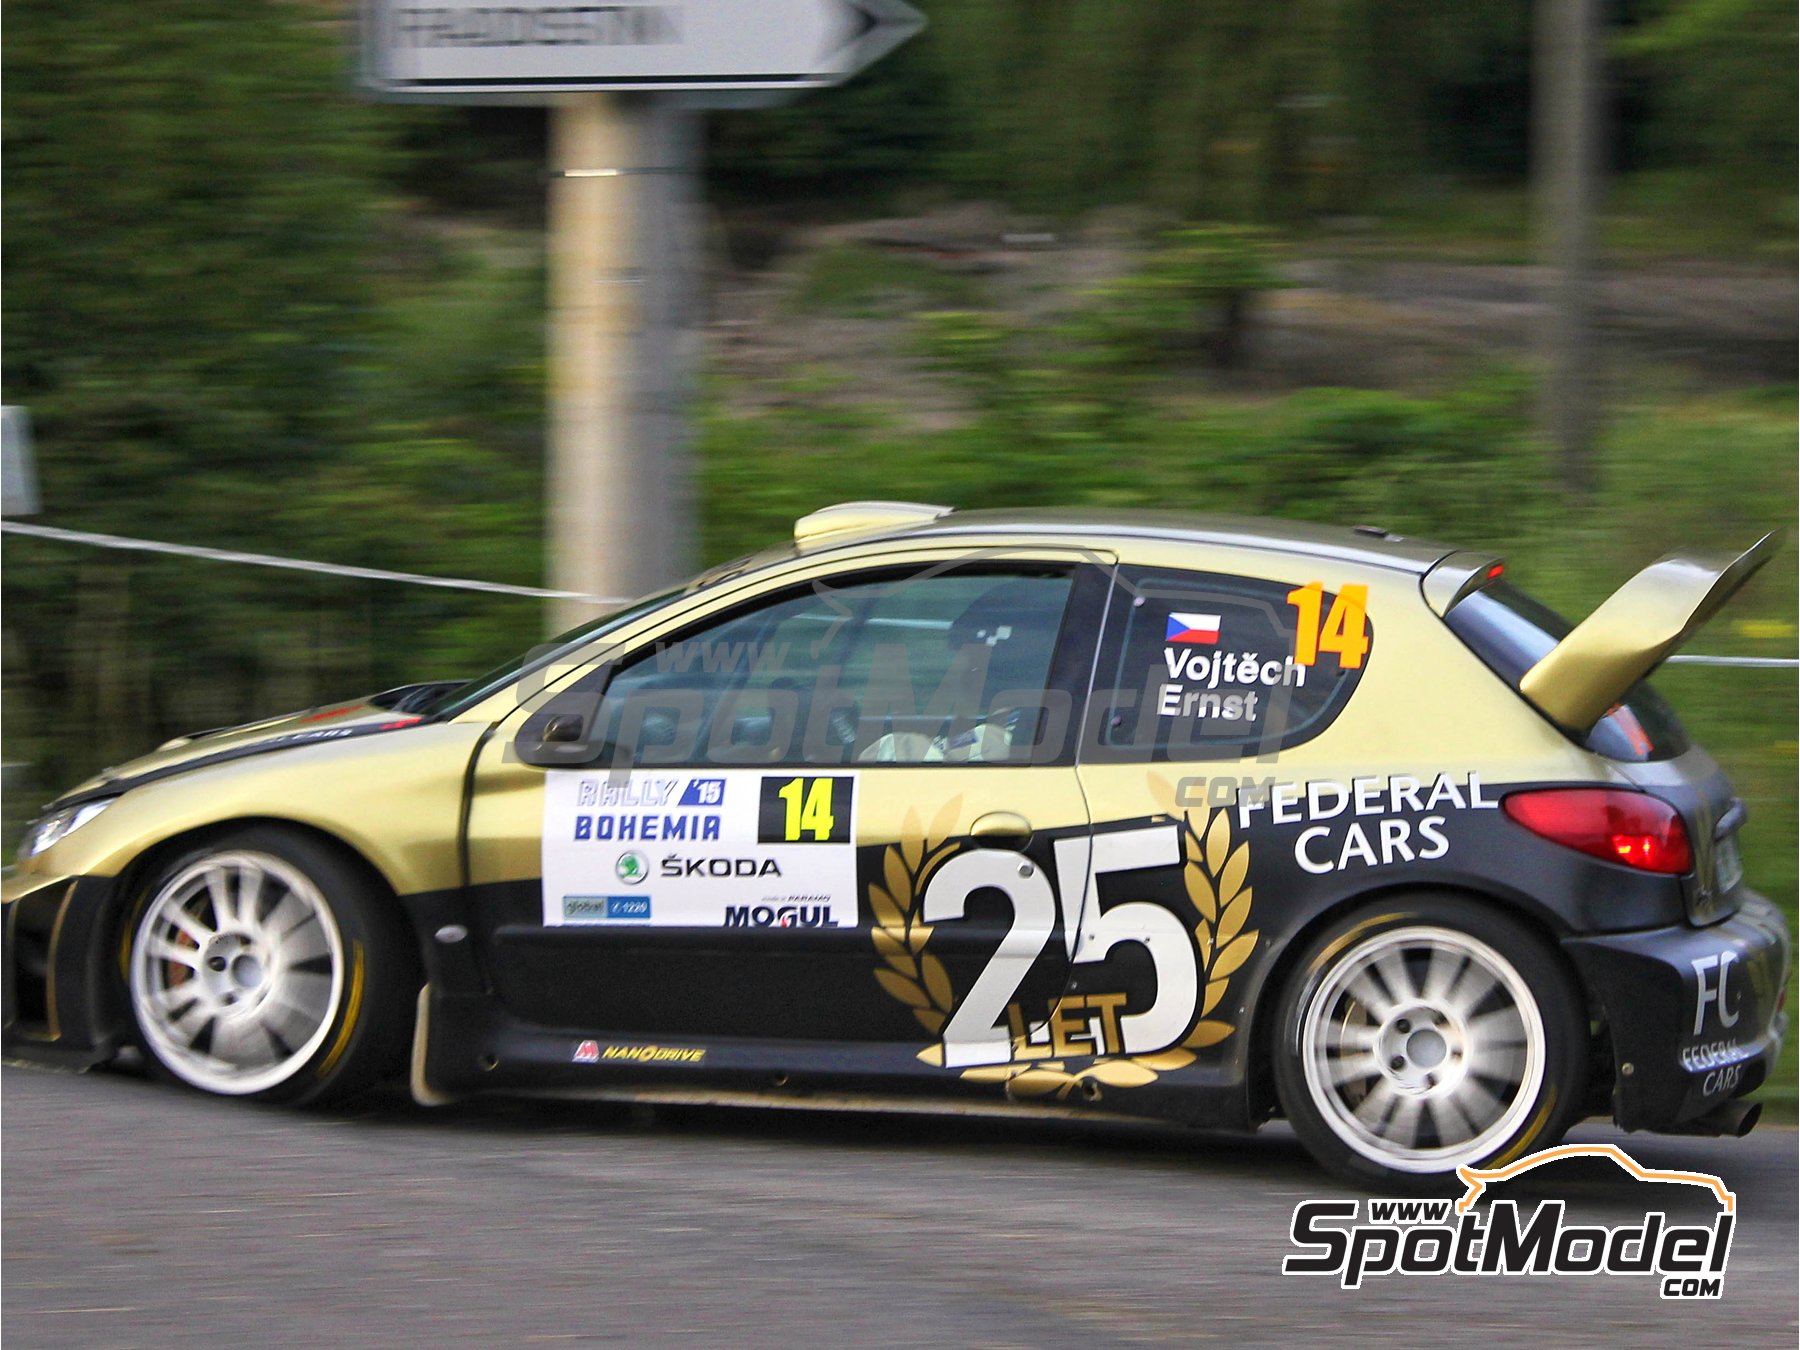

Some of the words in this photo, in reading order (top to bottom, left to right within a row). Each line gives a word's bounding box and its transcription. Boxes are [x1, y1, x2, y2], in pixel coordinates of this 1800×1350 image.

[1287, 581, 1369, 669] 14
[1163, 648, 1307, 689] Vojtěch
[1157, 684, 1259, 722] Ernst
[576, 779, 679, 807] RALLY
[777, 777, 834, 841] 14
[1236, 771, 1499, 829] FEDERAL
[574, 815, 721, 841] BOHEMIA
[1294, 815, 1450, 875] CARS
[660, 853, 782, 877] ŠKODA
[723, 905, 839, 928] MOGUL
[923, 825, 1198, 1068] 25
[1691, 950, 1740, 1036] FC
[1009, 992, 1128, 1060] LET
[602, 1045, 706, 1062] NANODRIVE
[1682, 1038, 1750, 1073] FEDERAL
[1702, 1064, 1742, 1097] CARS
